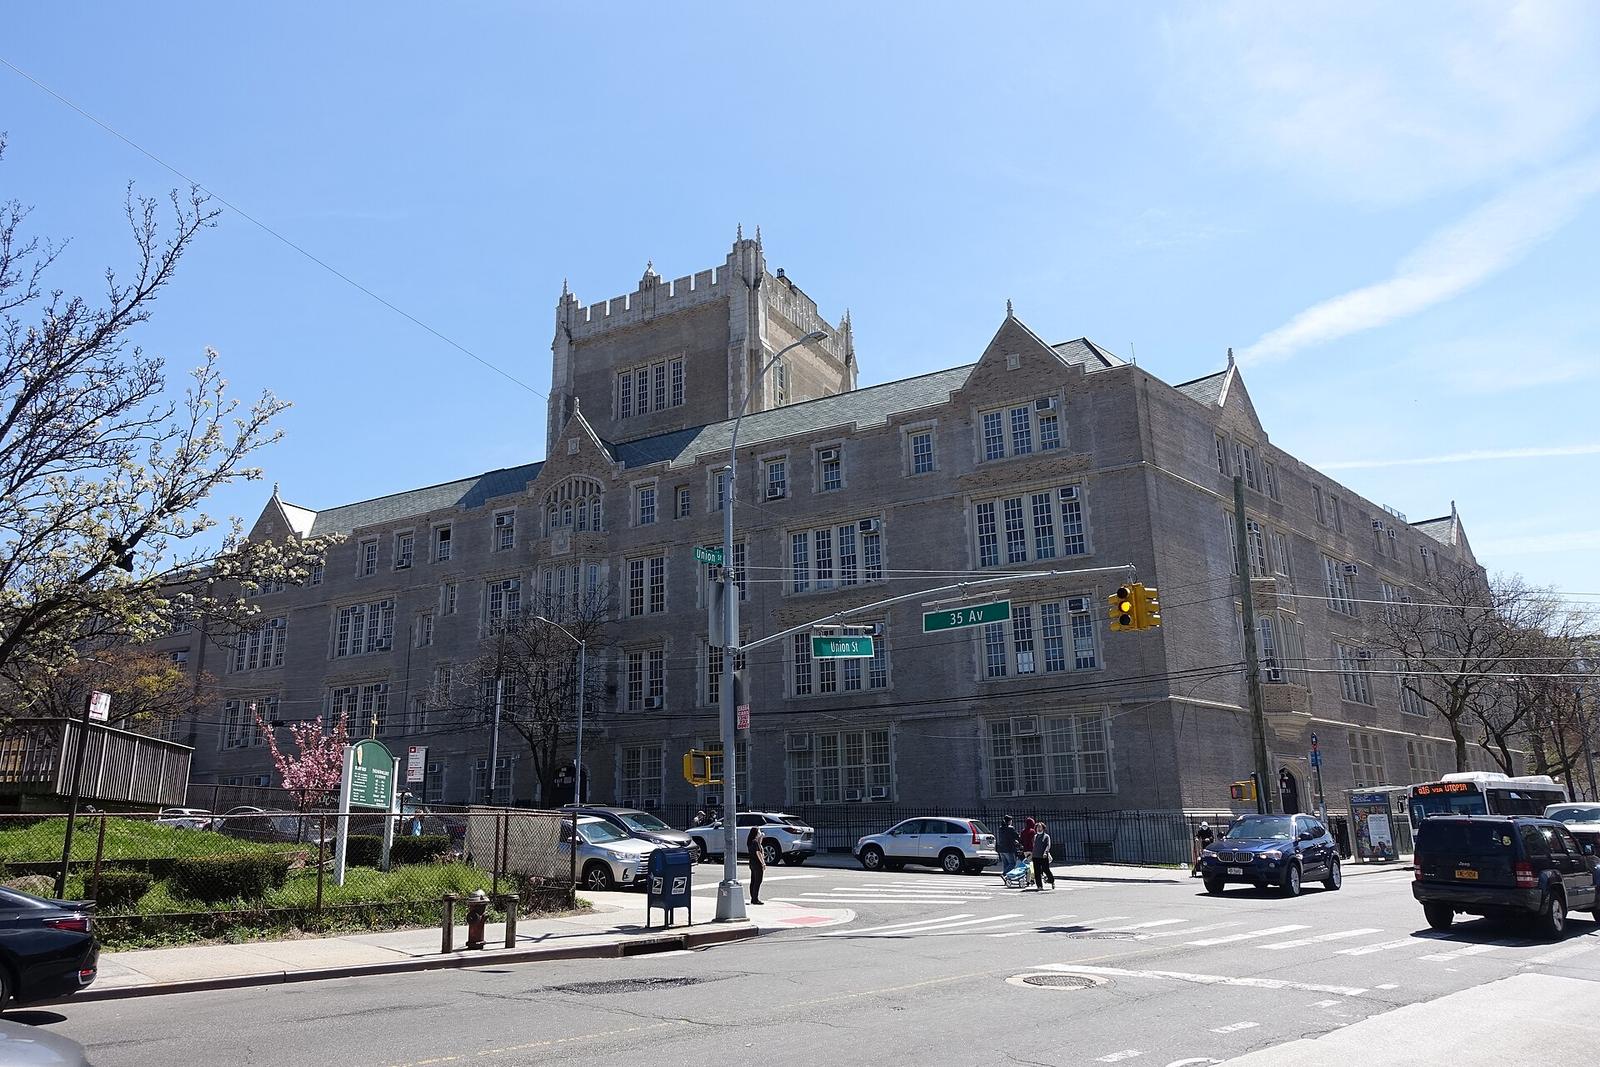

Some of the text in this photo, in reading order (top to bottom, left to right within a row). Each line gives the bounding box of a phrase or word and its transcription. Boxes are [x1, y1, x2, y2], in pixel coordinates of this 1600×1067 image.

[696, 549, 716, 563] Union
[950, 610, 983, 625] 35 Av
[830, 641, 859, 653] Union St
[1444, 783, 1468, 792] UTOPIA
